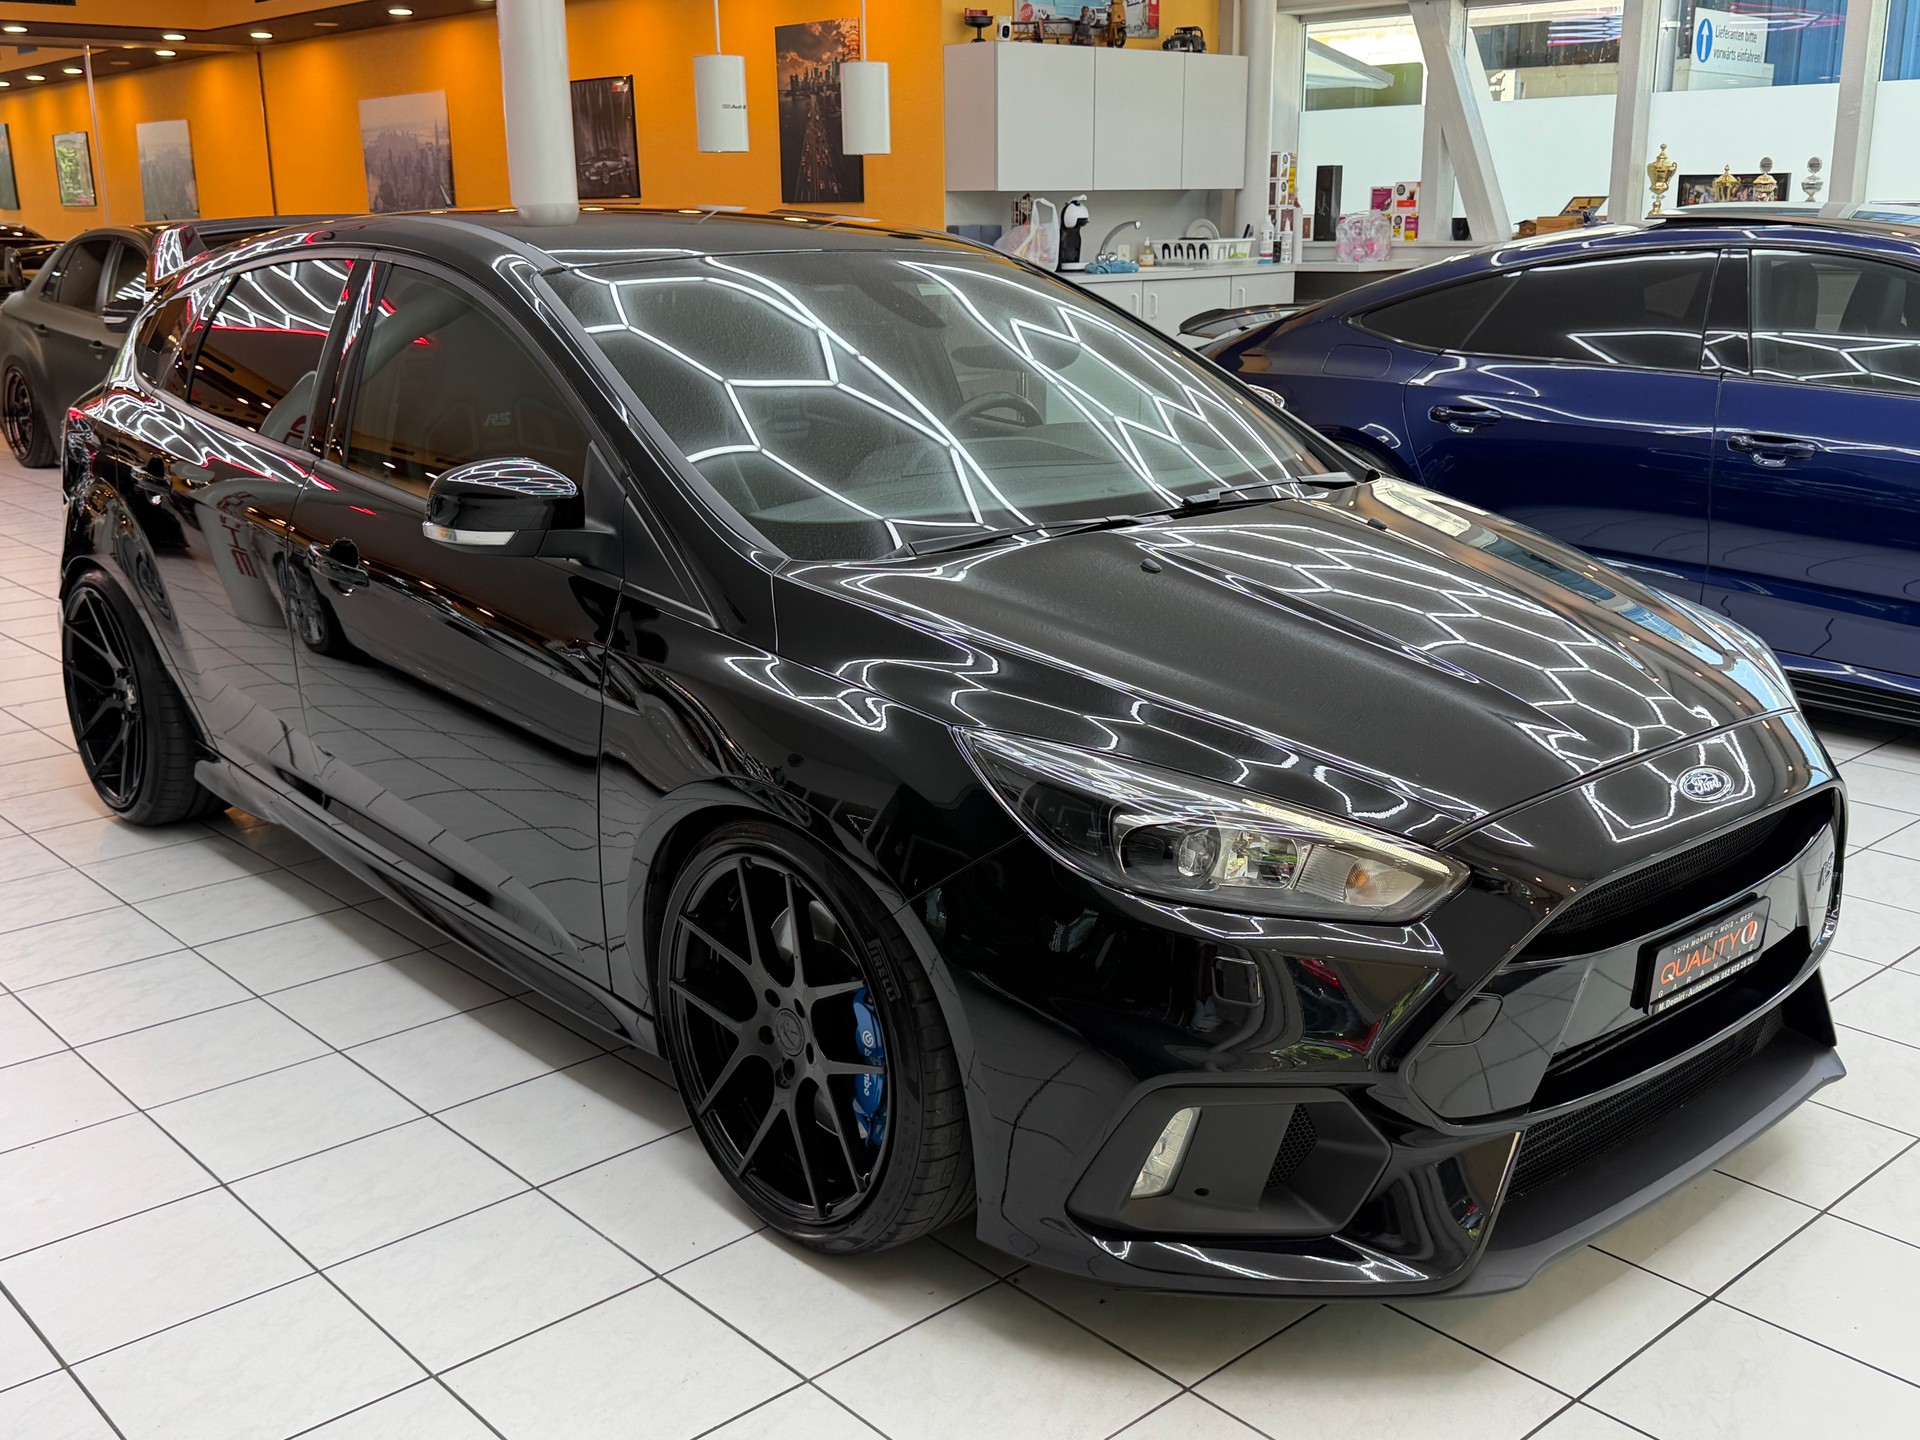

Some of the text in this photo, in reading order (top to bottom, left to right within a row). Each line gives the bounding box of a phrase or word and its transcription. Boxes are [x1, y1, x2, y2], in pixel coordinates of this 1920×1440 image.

[1715, 25, 1758, 43] Lieferanten bitte
[1713, 47, 1763, 63] vorwärts einfahren!
[484, 412, 511, 427] RS
[1690, 774, 1722, 795] Ford
[1673, 943, 1689, 955] 12/24
[1690, 931, 1714, 947] MONATE
[1720, 920, 1734, 933] MOIS
[867, 938, 902, 1002] PIRELLI
[864, 1048, 872, 1097] bmbo
